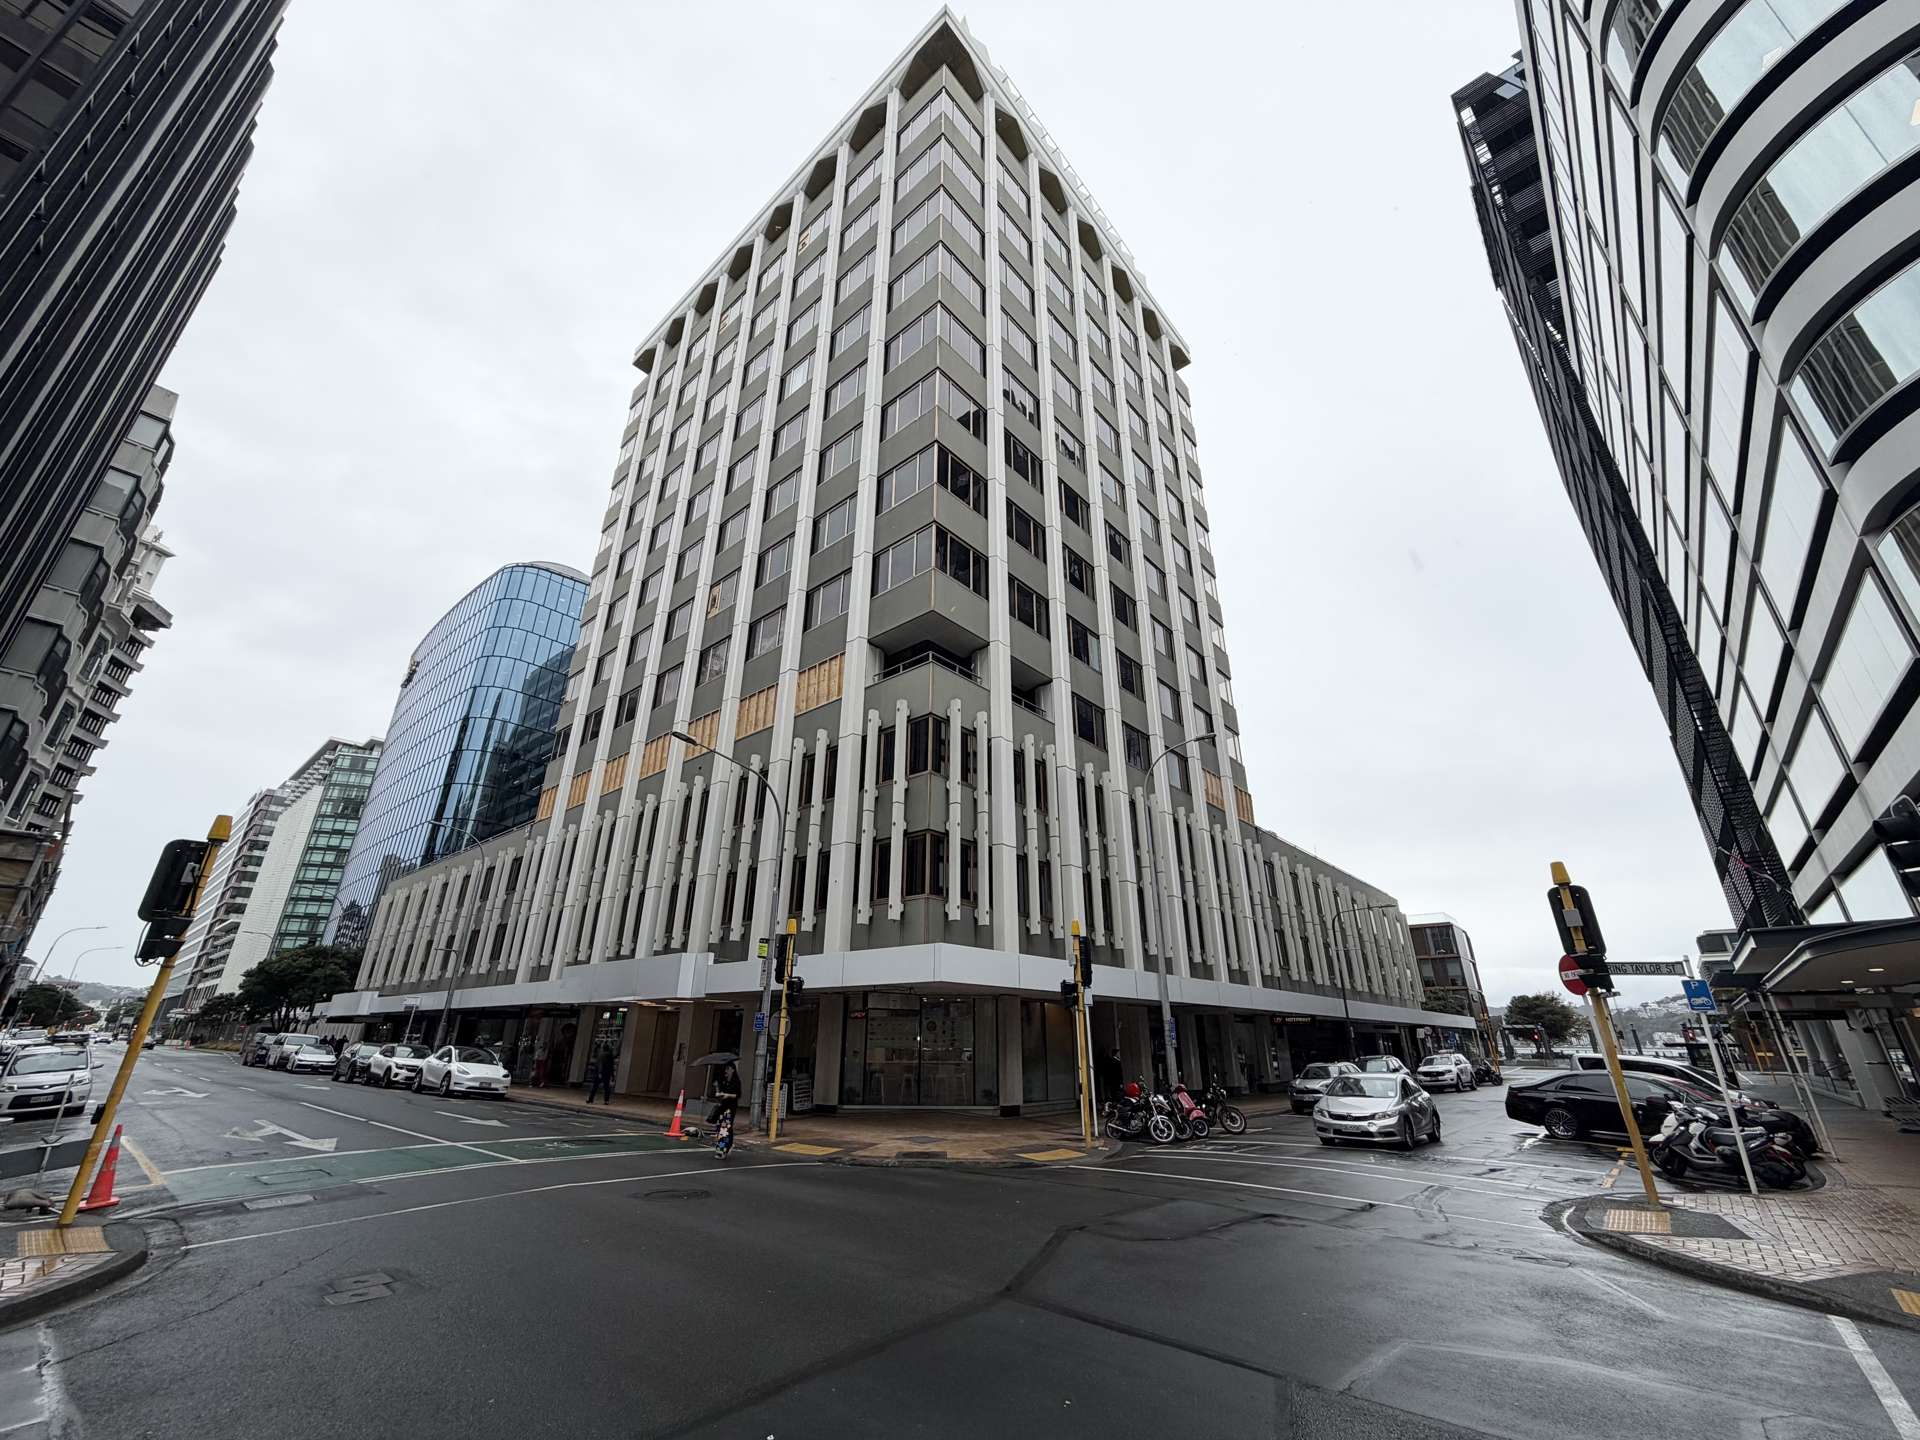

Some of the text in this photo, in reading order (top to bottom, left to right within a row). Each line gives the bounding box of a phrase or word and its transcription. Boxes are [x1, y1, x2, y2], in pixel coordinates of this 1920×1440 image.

[1630, 964, 1662, 974] TAYLOR
[1665, 964, 1677, 974] ST
[1691, 981, 1699, 990] P
